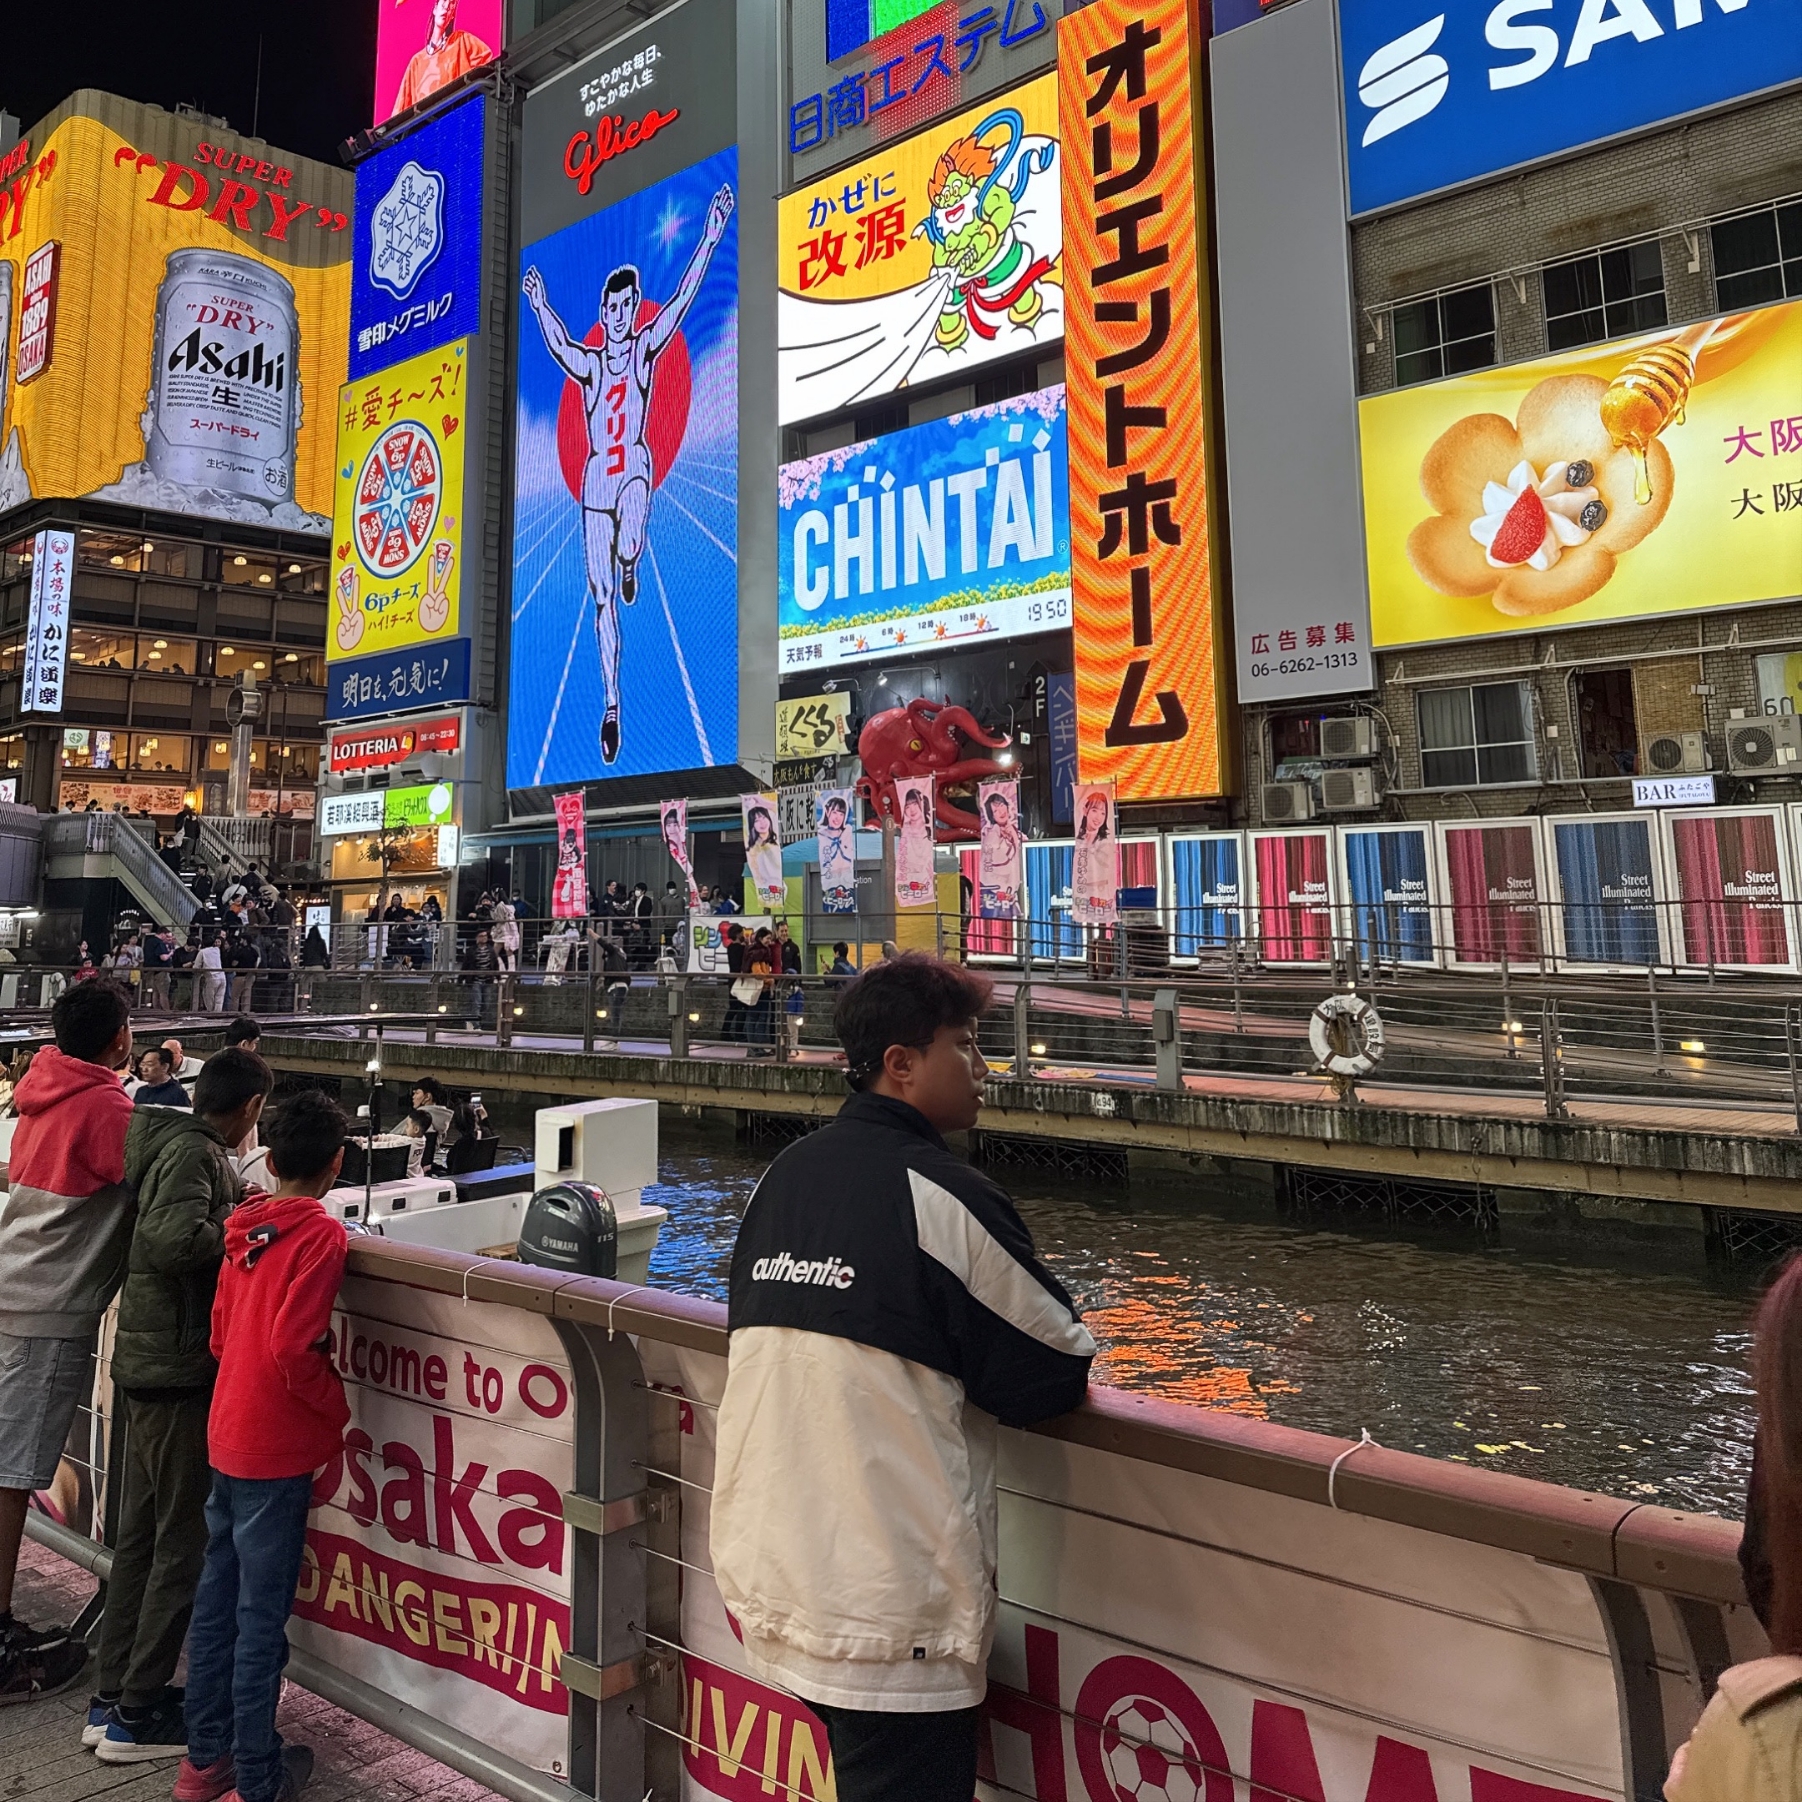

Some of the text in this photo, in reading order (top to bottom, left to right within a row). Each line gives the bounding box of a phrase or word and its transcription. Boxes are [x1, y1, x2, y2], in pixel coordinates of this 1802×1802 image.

[579, 44, 662, 102] すこやかな毎日、
[584, 68, 653, 117] ゆたかな人生
[790, 0, 1046, 154] 日商エステム
[194, 141, 294, 188] SUPER
[564, 108, 679, 195] Glico
[807, 171, 896, 229] かぜに
[798, 196, 907, 291] 改源
[21, 297, 49, 341] 1889
[211, 295, 254, 313] SUPER
[357, 291, 452, 352] 雪印メグミルク
[18, 333, 45, 376] OSAKA
[168, 327, 285, 393] Asahi
[212, 385, 241, 408] 生
[1086, 18, 1190, 748] オリエントホーム
[189, 418, 260, 441] スーパードライ
[605, 375, 629, 477] グリコ
[793, 423, 1054, 612] CHINTAI
[786, 643, 823, 664] 天気予報
[1251, 621, 1356, 655] 広告募集
[1251, 652, 1358, 677] 06-6262-1313
[333, 737, 399, 761] LOTTERIA
[1637, 784, 1676, 801] BAR
[1620, 873, 1649, 886] Street
[1744, 869, 1775, 884] Street
[548, 1239, 579, 1253] YAMAHA
[597, 1232, 614, 1243] 115
[752, 1252, 855, 1290] authentic
[329, 1316, 448, 1400] lcome
[463, 1351, 504, 1414] to
